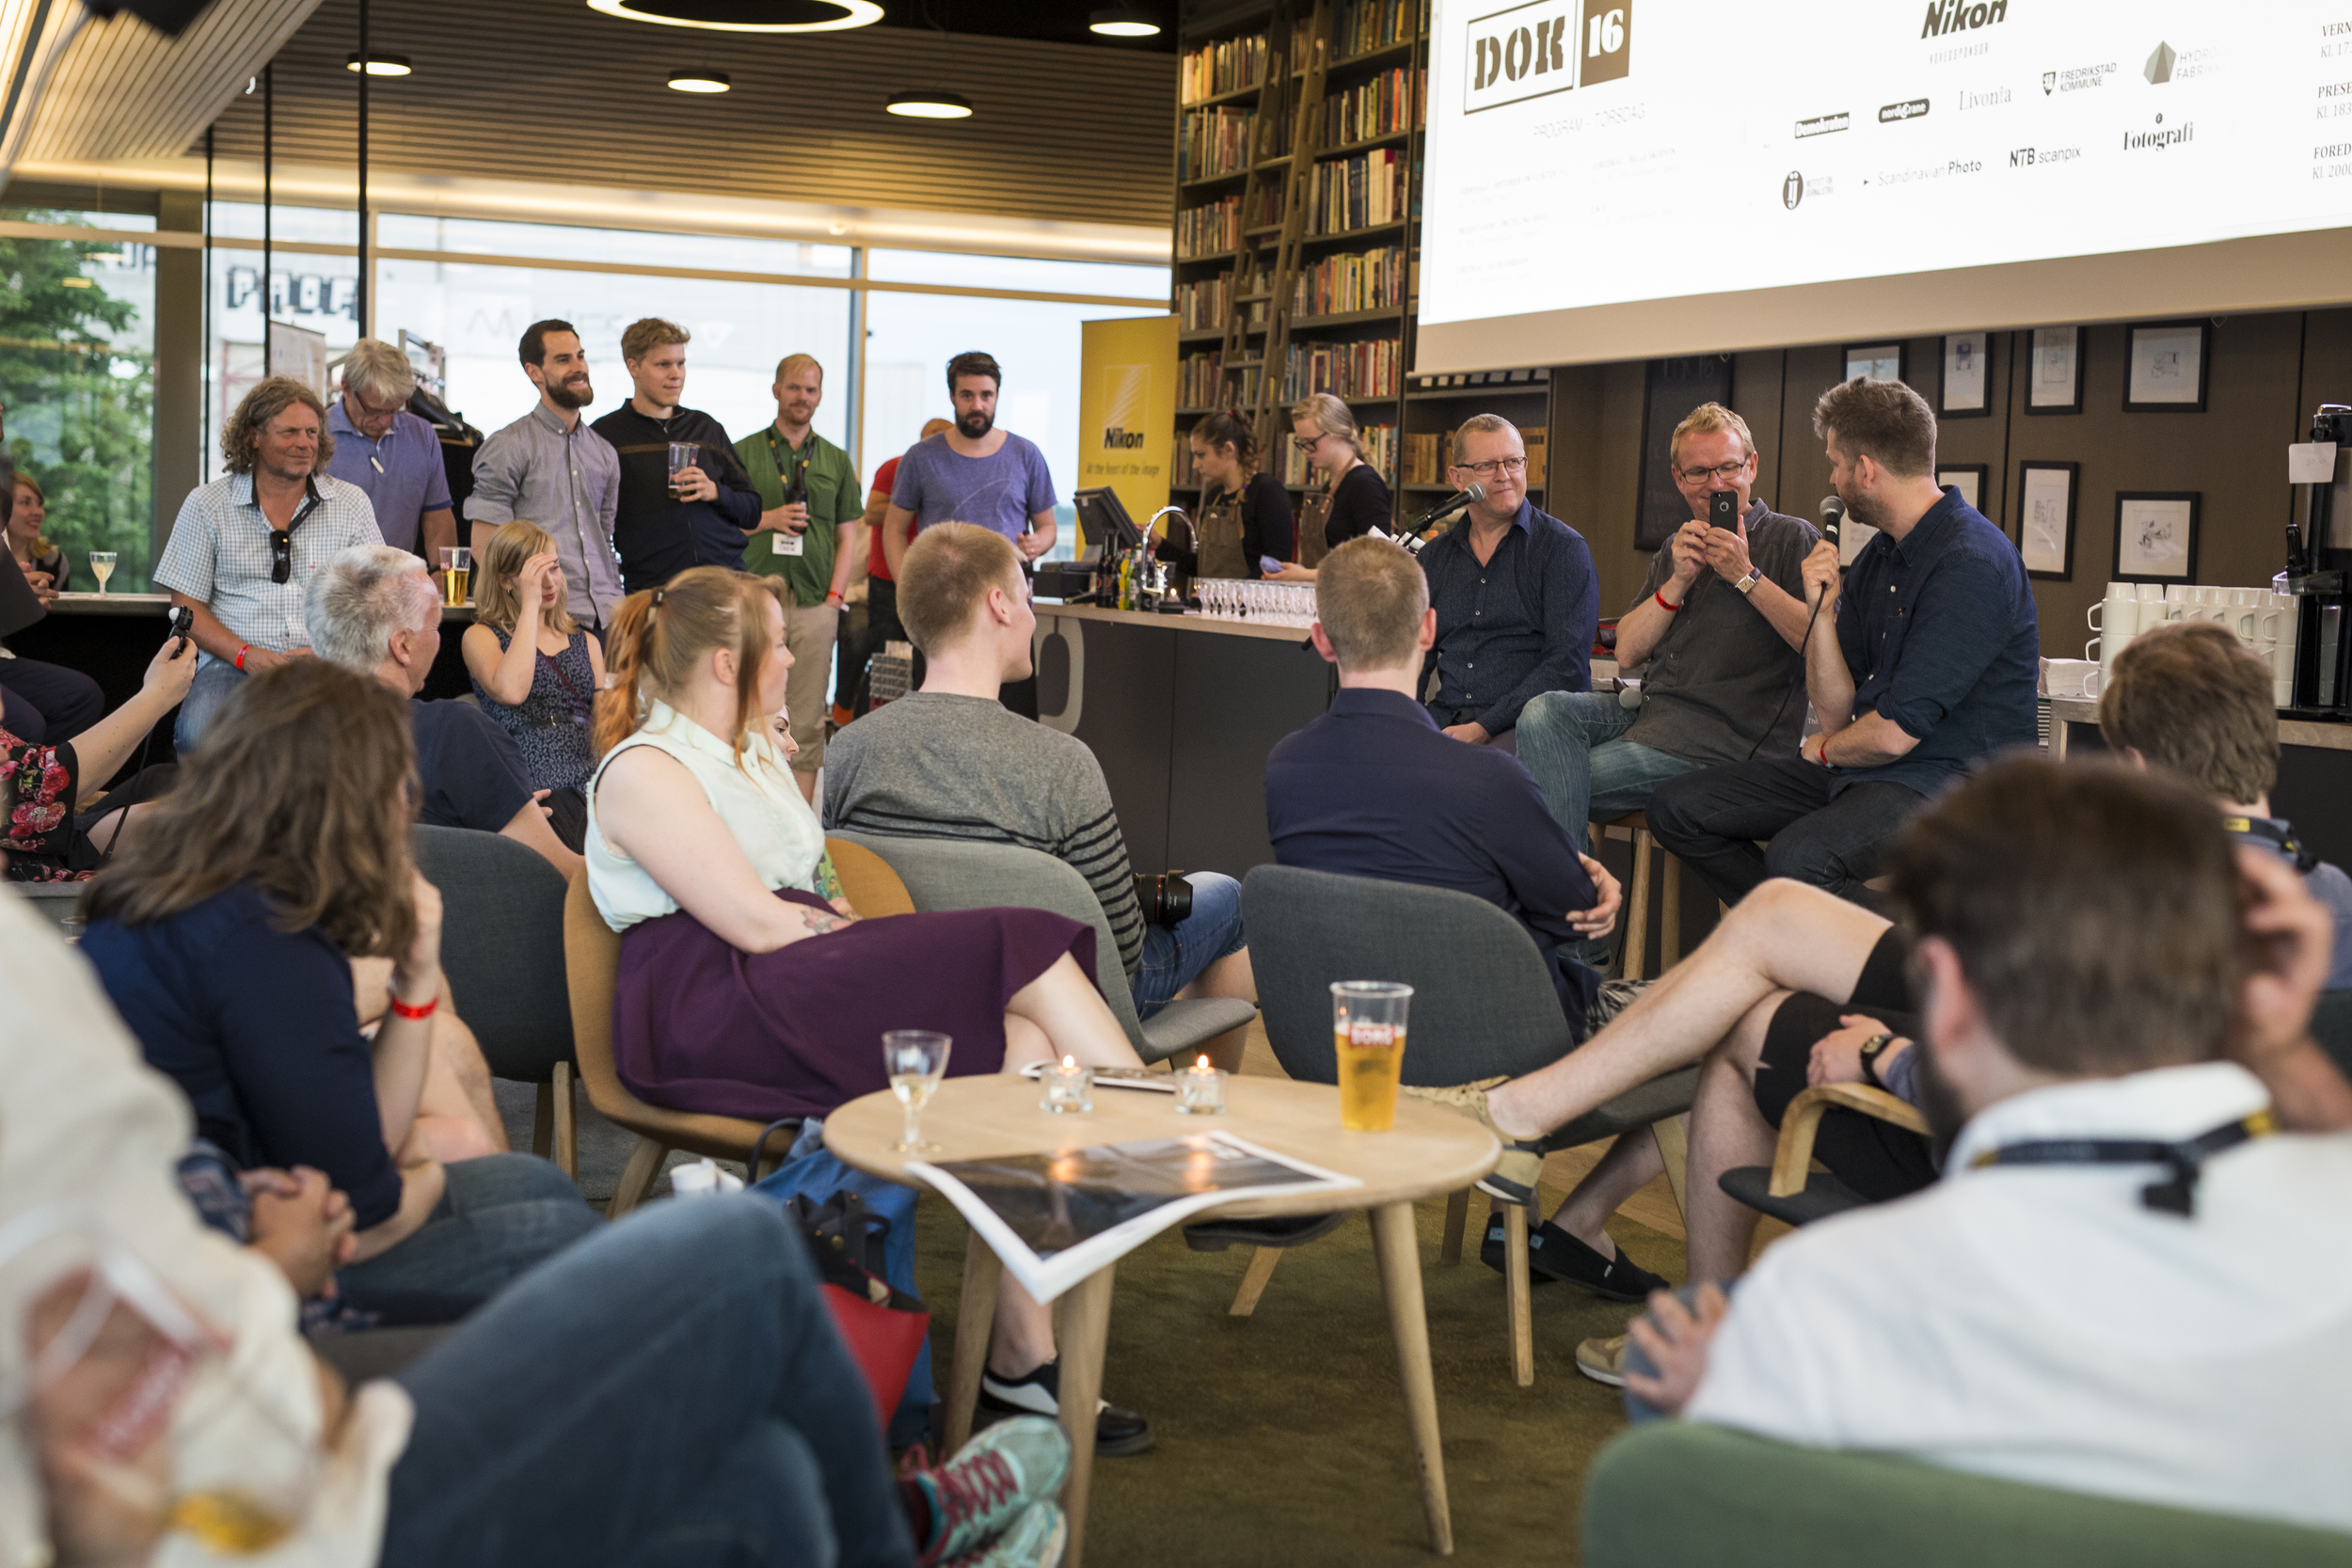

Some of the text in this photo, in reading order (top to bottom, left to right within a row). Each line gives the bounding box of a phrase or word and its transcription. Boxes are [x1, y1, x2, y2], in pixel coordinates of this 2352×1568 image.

[1921, 0, 2008, 39] Nikon
[1474, 9, 1624, 91] DOK 16
[2060, 62, 2117, 82] FREDRIKSTAD
[2060, 75, 2103, 92] KOMMUNE
[1959, 86, 2011, 110] Livonia
[1534, 118, 1582, 139] PROGRAM
[1596, 103, 1645, 127] TORSDAG
[1795, 116, 1850, 138] Demokraten
[2123, 121, 2194, 151] Fotografi
[2010, 145, 2082, 167] NTB scanpix
[2314, 143, 2352, 159] FORED
[1879, 159, 1981, 186] Scandinavian Photo
[1104, 428, 1144, 449] Nikon
